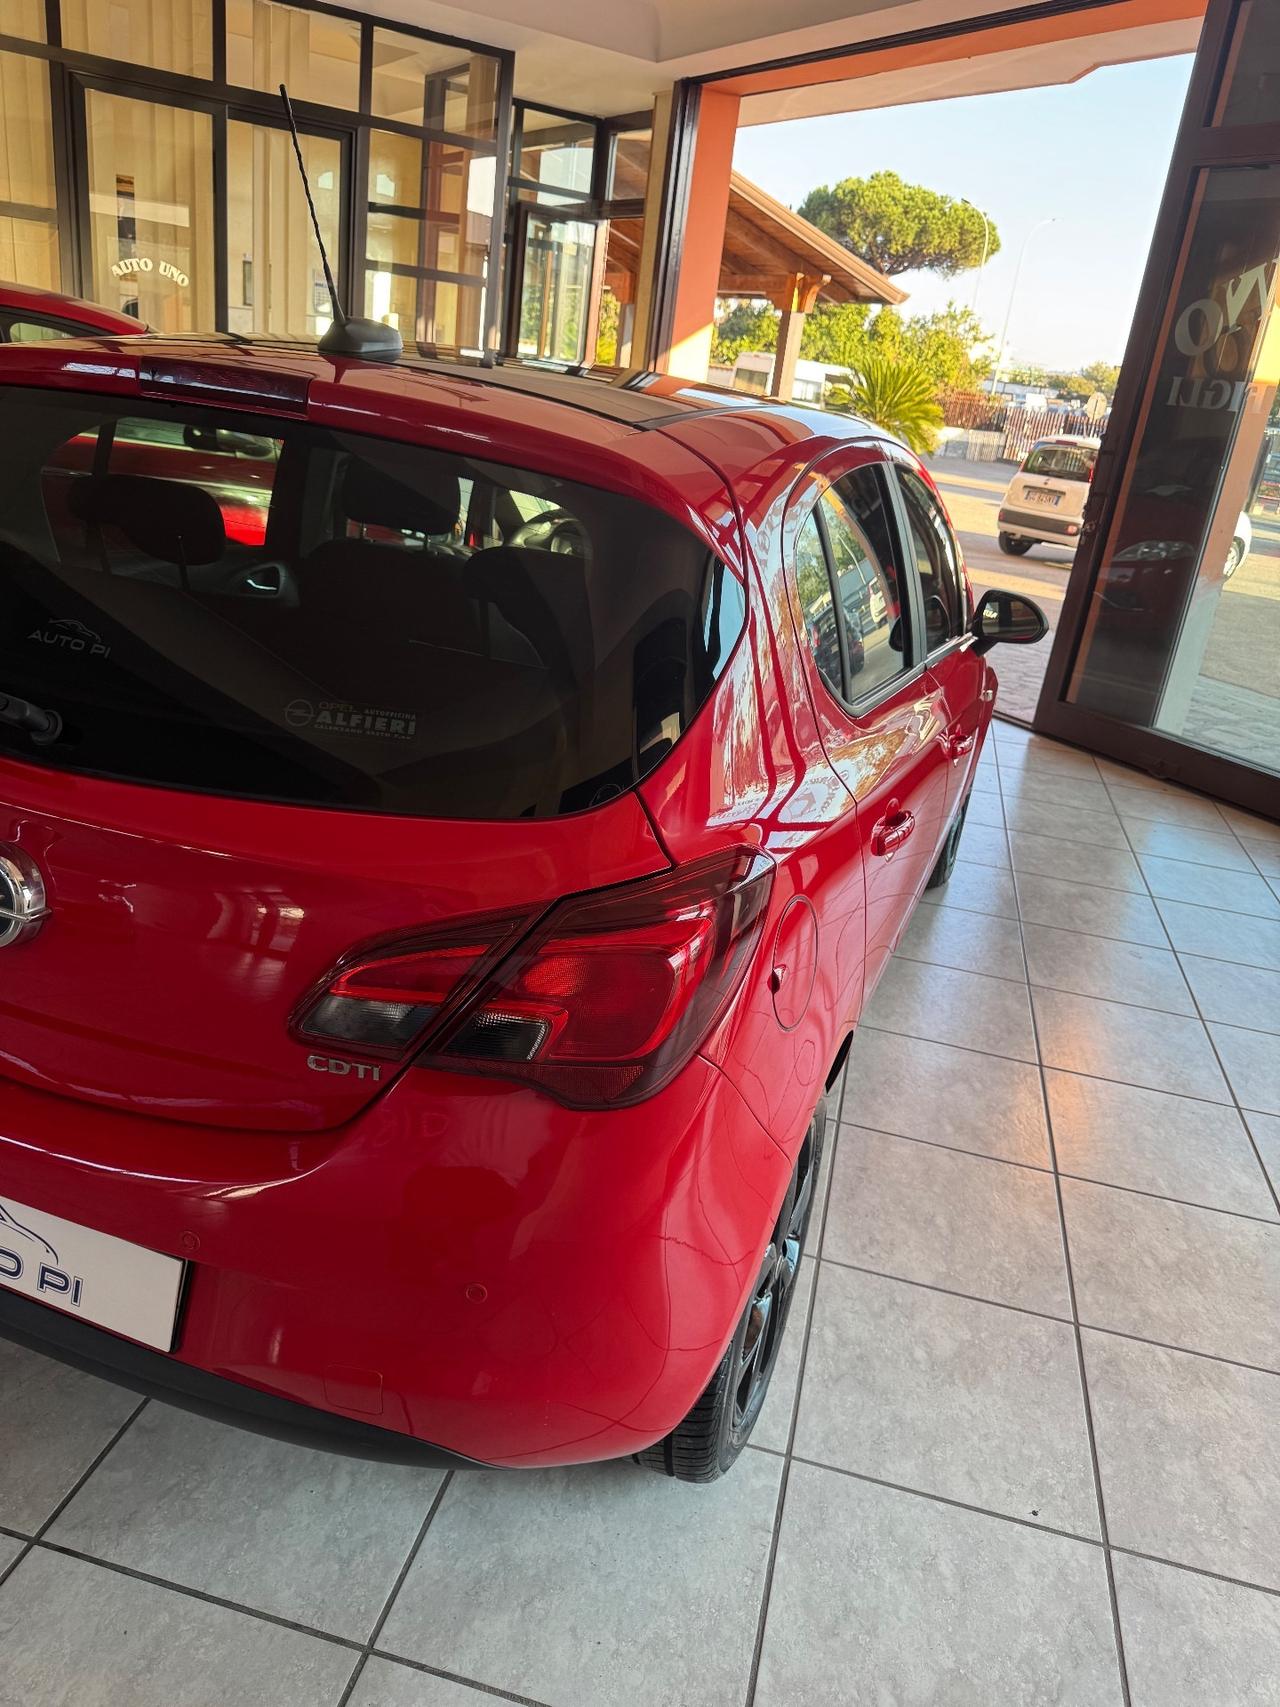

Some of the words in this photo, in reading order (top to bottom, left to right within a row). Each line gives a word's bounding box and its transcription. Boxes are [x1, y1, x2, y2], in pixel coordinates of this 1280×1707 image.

[111, 257, 153, 277] AUTO
[158, 260, 189, 287] UNO
[27, 630, 85, 651] AUTO
[89, 643, 112, 659] PI
[315, 710, 416, 735] ALFIERI
[307, 1055, 380, 1081] CDTI
[37, 1262, 84, 1307] PI
